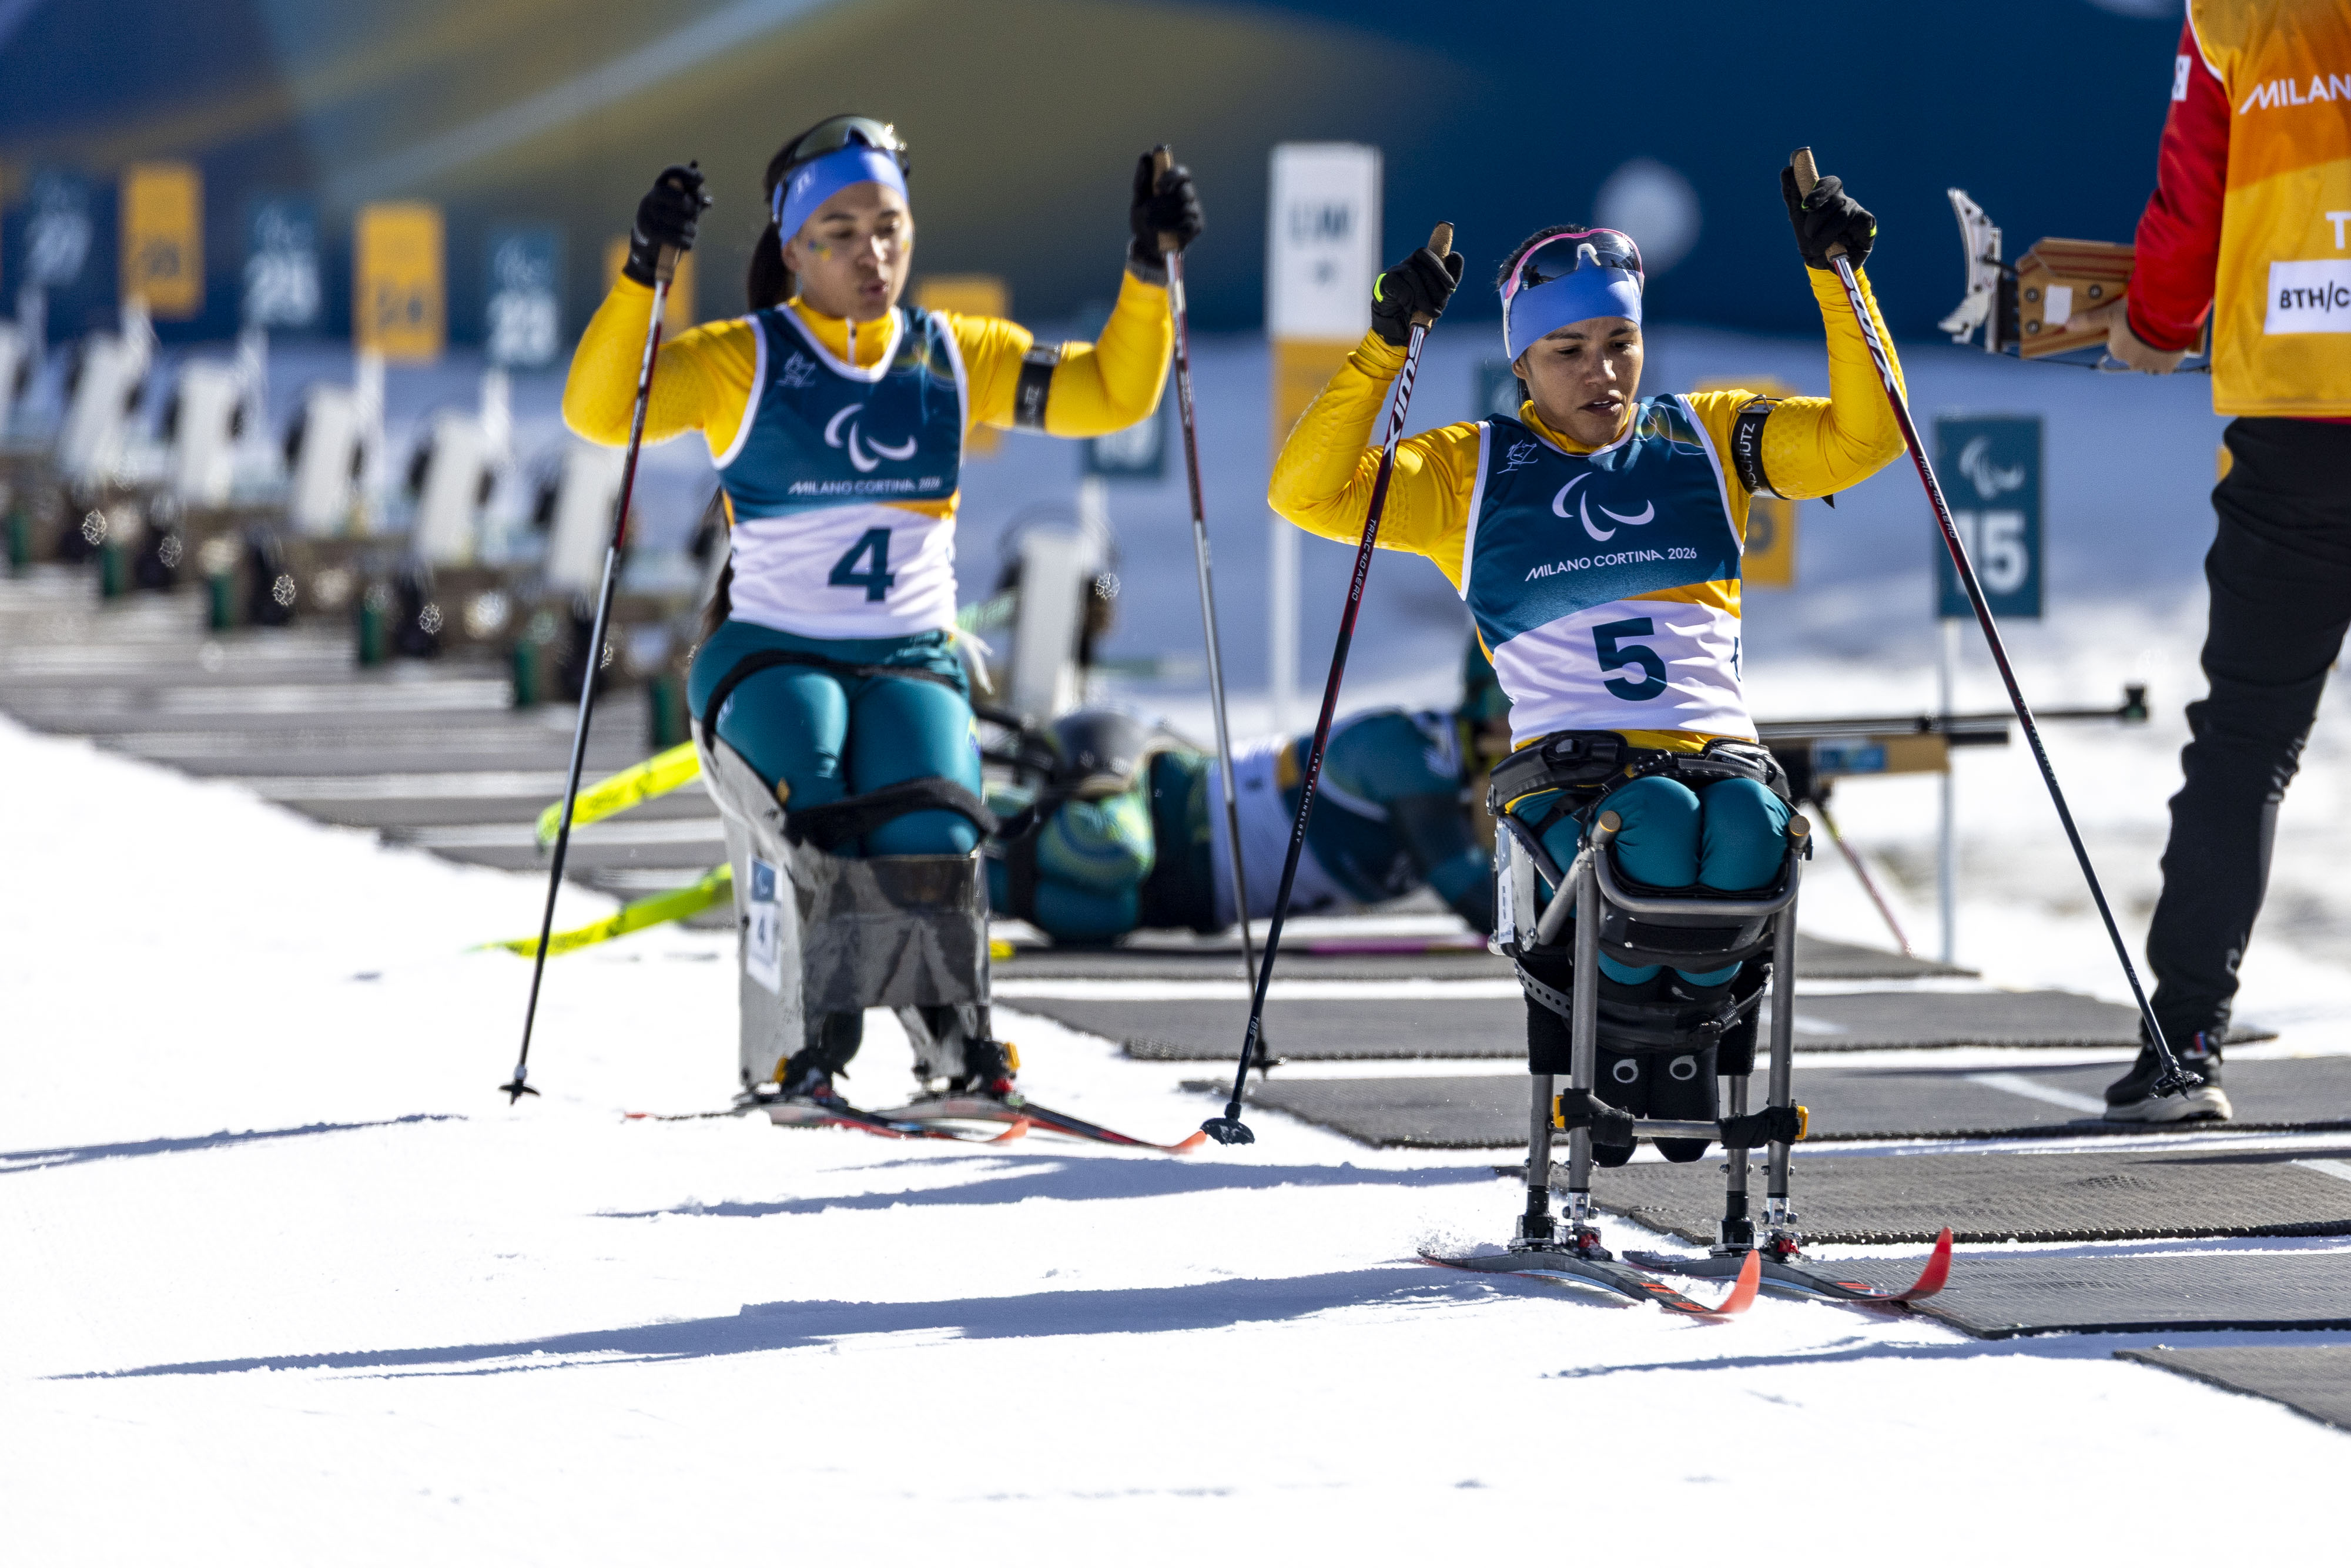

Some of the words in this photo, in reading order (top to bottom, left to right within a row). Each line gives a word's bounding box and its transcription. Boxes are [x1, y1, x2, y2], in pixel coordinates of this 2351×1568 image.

[2239, 73, 2351, 115] MILAN
[2325, 211, 2351, 250] T
[2279, 280, 2350, 313] BTH/C
[788, 480, 852, 495] MILANO
[855, 478, 915, 494] CORTINA
[1918, 456, 1936, 487] TRIAC
[1939, 507, 1957, 539] AERO
[1363, 519, 1377, 552] TRIAC
[1955, 510, 2029, 594] 15
[828, 527, 895, 603] 4
[1359, 553, 1369, 568] 4.0
[1525, 558, 1591, 582] MILANO
[1593, 550, 1665, 567] CORTINA
[1667, 547, 1697, 559] 2026
[1351, 568, 1365, 601] AERO
[1592, 617, 1667, 701] 5
[1296, 779, 1314, 843] TECHNOLOGY
